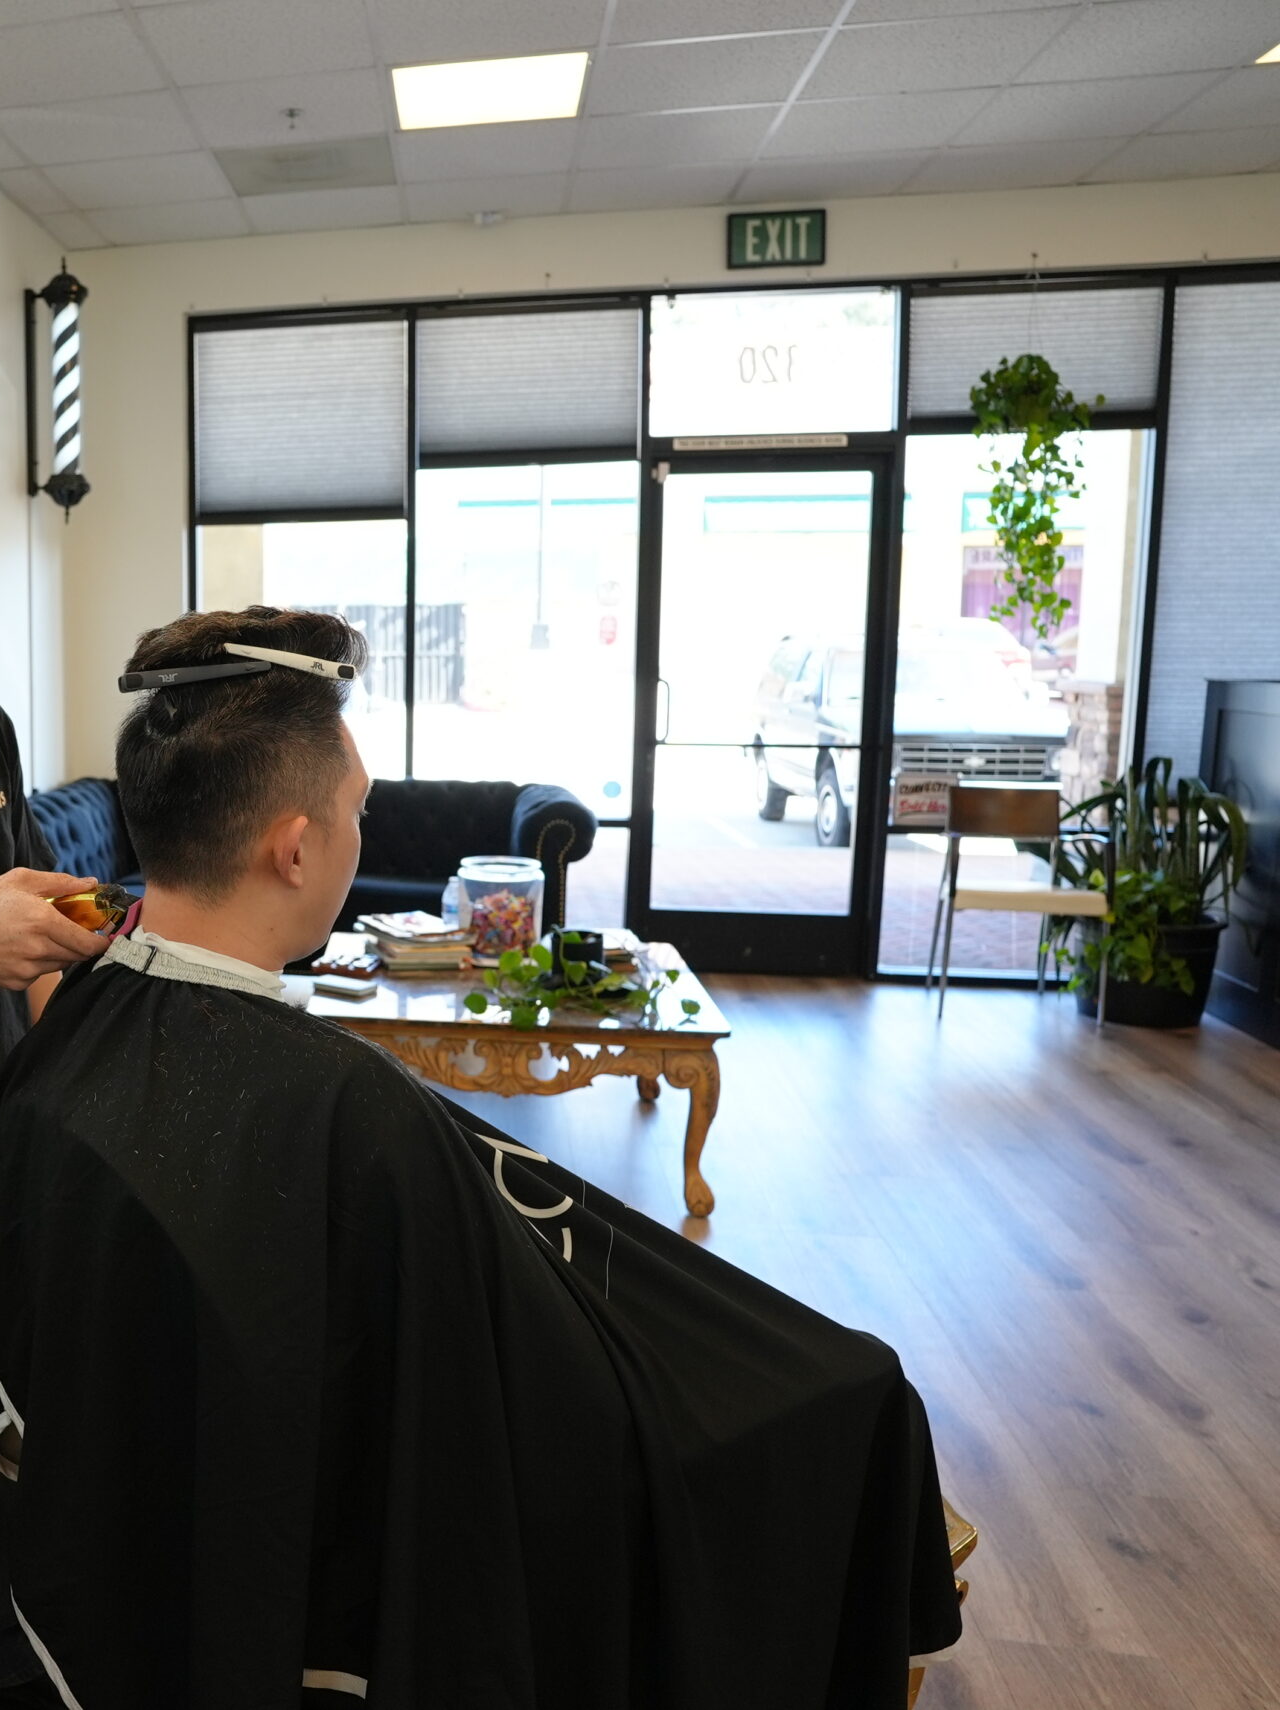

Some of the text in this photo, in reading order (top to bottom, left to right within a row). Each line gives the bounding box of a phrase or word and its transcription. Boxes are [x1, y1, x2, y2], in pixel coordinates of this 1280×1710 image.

[745, 216, 811, 263] EXIT
[310, 660, 326, 672] JRL
[157, 672, 178, 683] JRL
